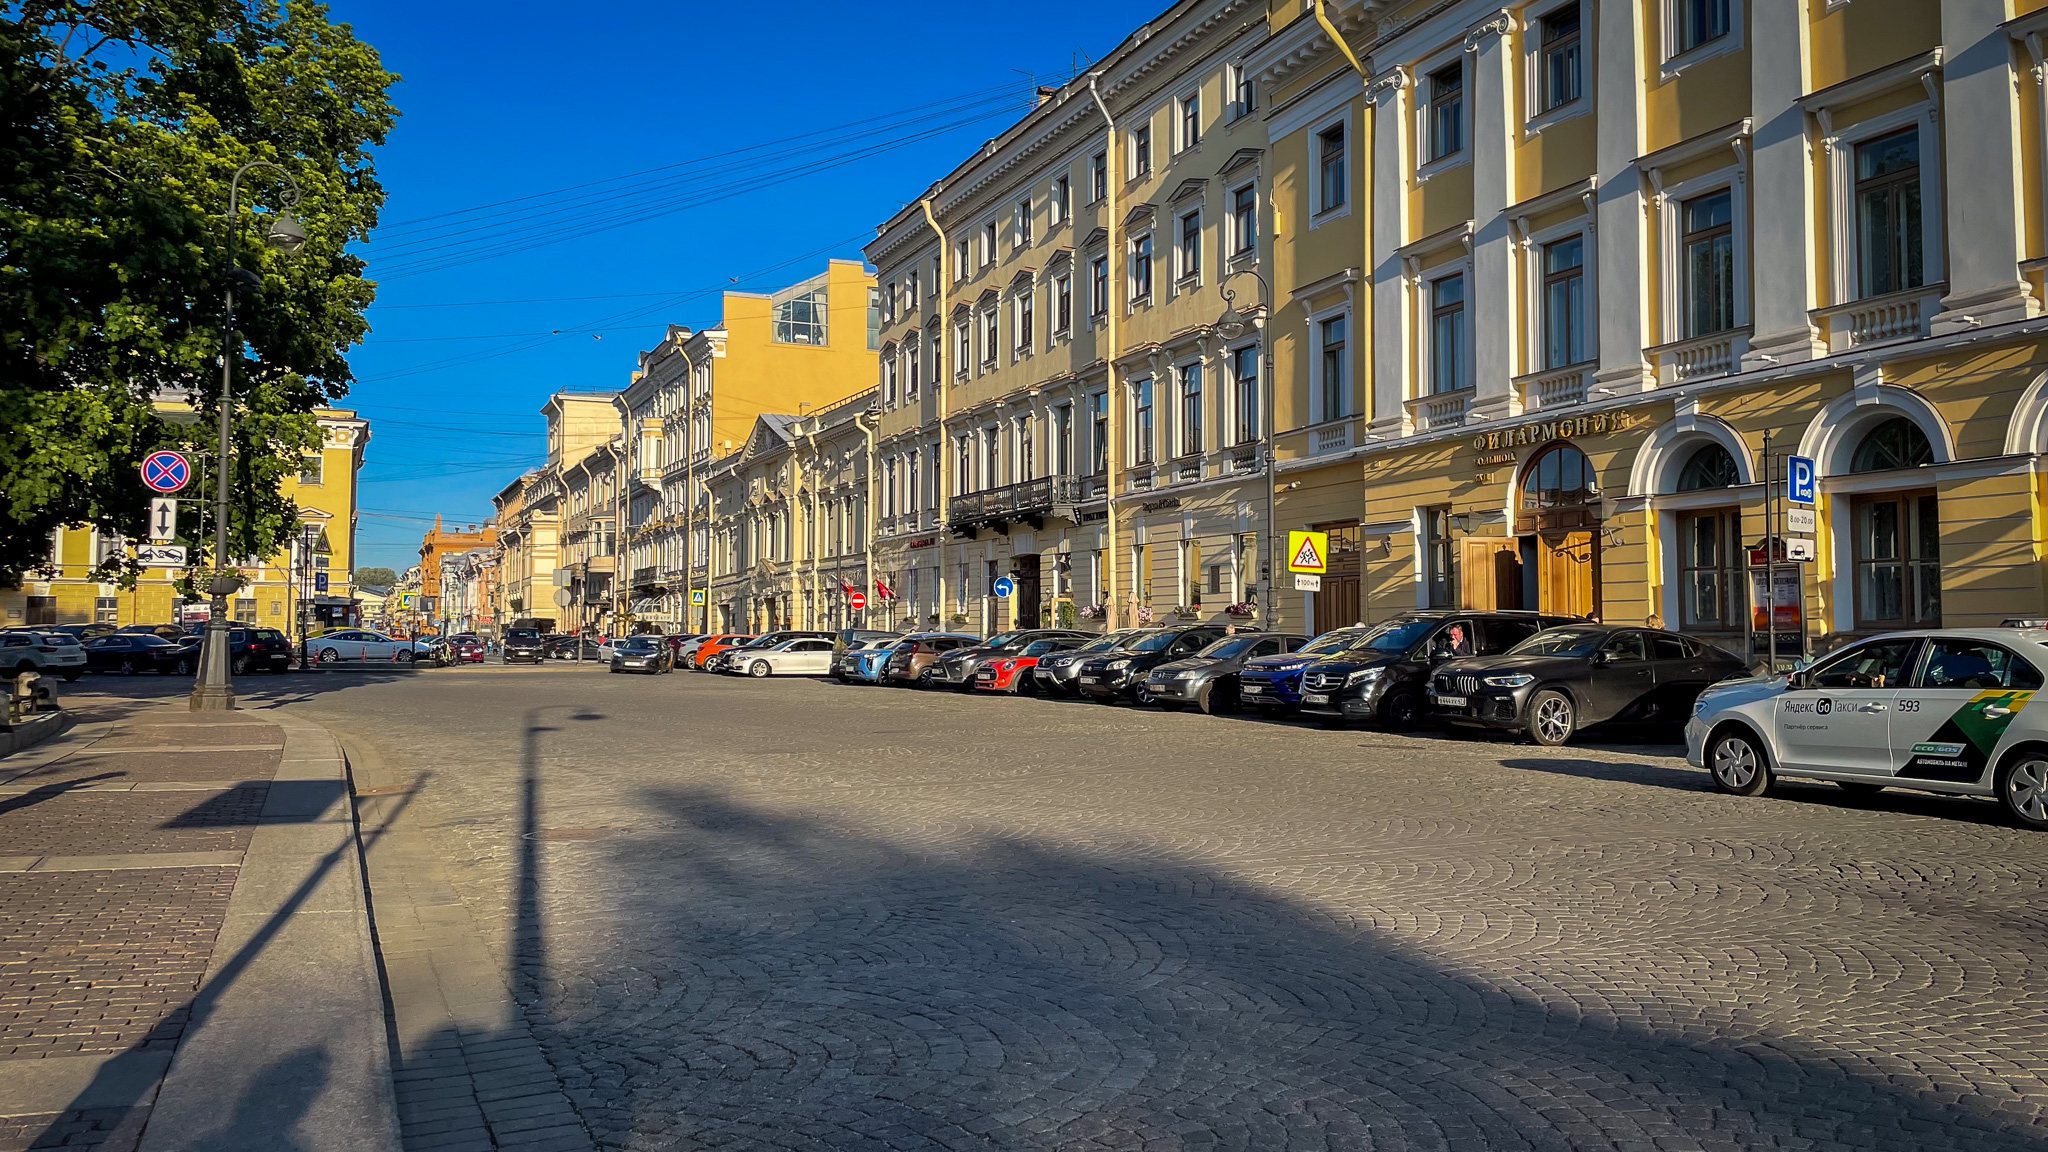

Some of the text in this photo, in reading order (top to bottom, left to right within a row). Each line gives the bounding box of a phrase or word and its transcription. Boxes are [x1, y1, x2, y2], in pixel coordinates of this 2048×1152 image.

[1473, 410, 1626, 450] ФИЛАРМОНИЯ
[1796, 462, 1810, 497] P
[1784, 700, 1858, 714] Яндекс Go Такси
[1898, 700, 1920, 712] 593
